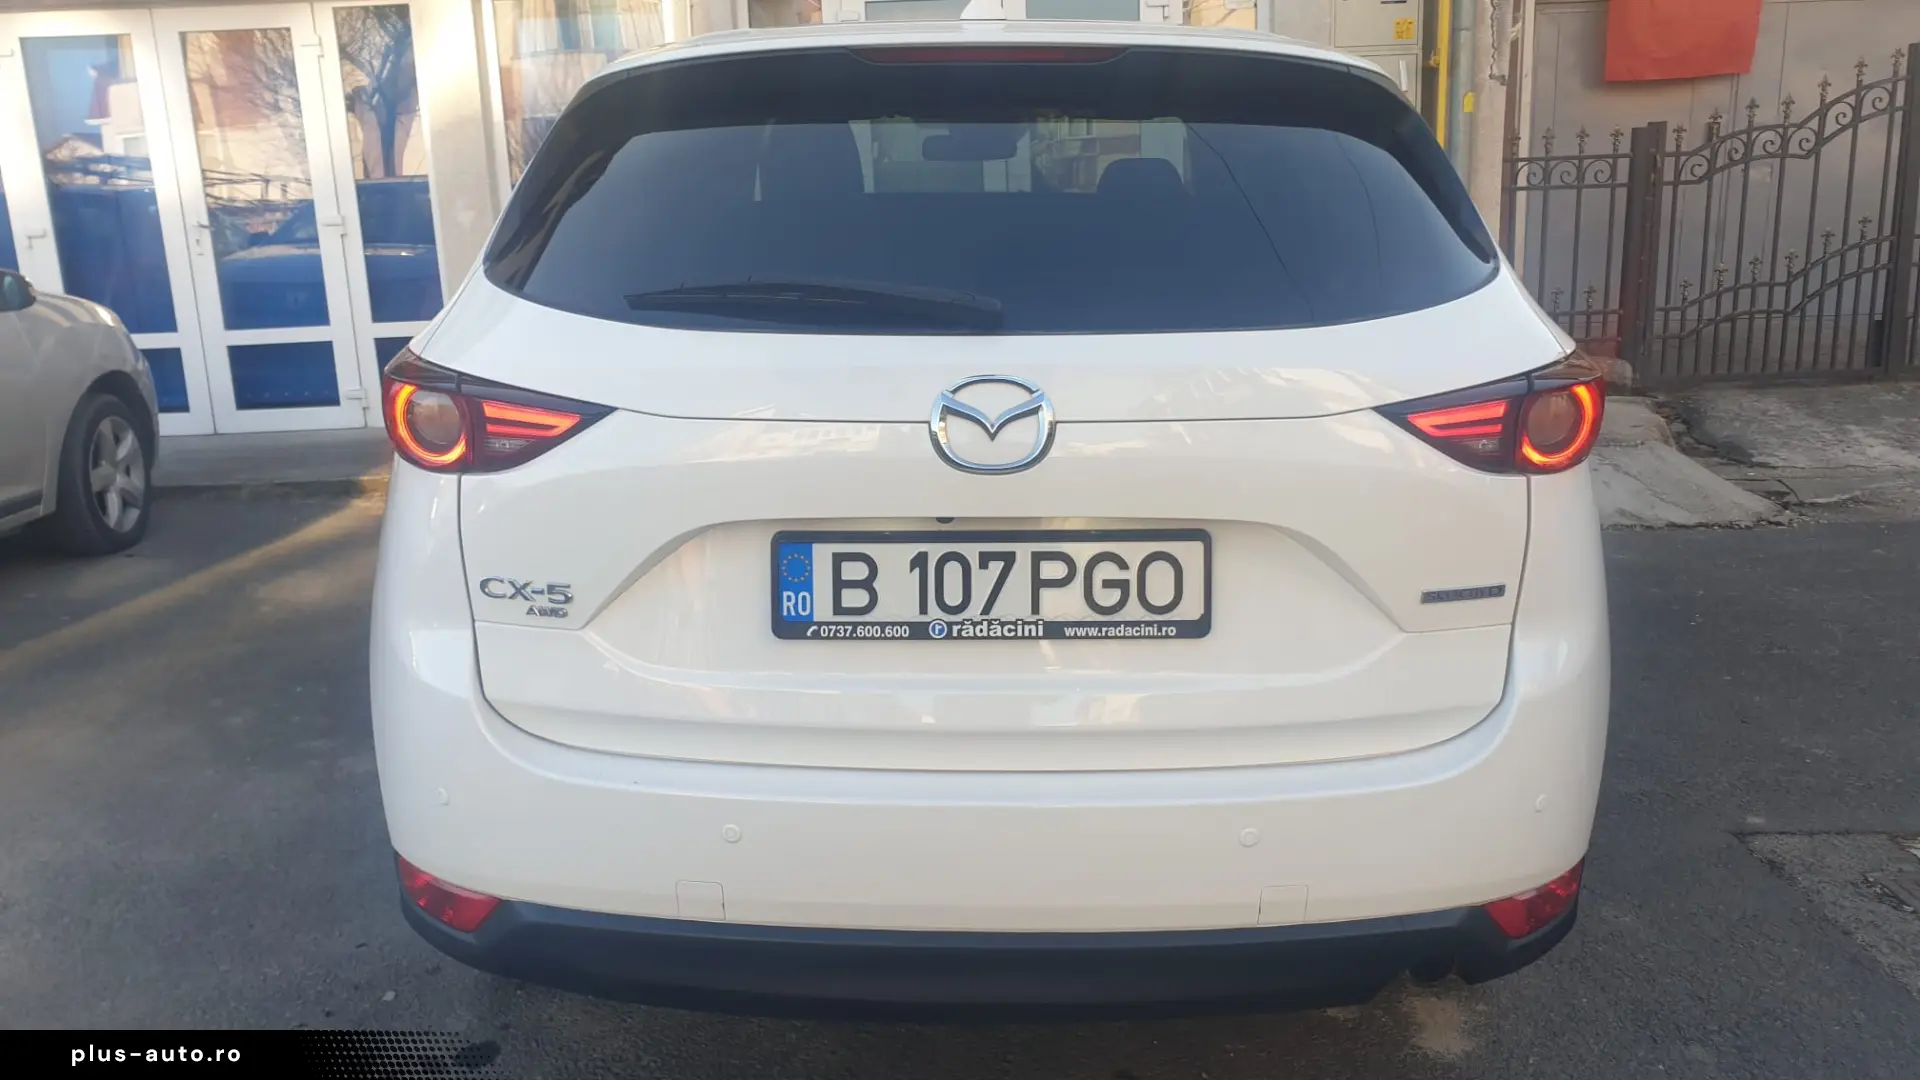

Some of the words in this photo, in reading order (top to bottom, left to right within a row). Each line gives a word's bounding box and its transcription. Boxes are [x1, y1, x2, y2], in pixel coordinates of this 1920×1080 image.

[479, 576, 574, 605] CX-5
[832, 552, 879, 616] B
[909, 551, 1017, 616] 107
[1030, 551, 1184, 616] PGO
[782, 591, 811, 616] RO
[820, 625, 910, 638] 0737.600.600
[952, 620, 1044, 638] rădăcini
[1064, 624, 1177, 638] www.radacini.ro
